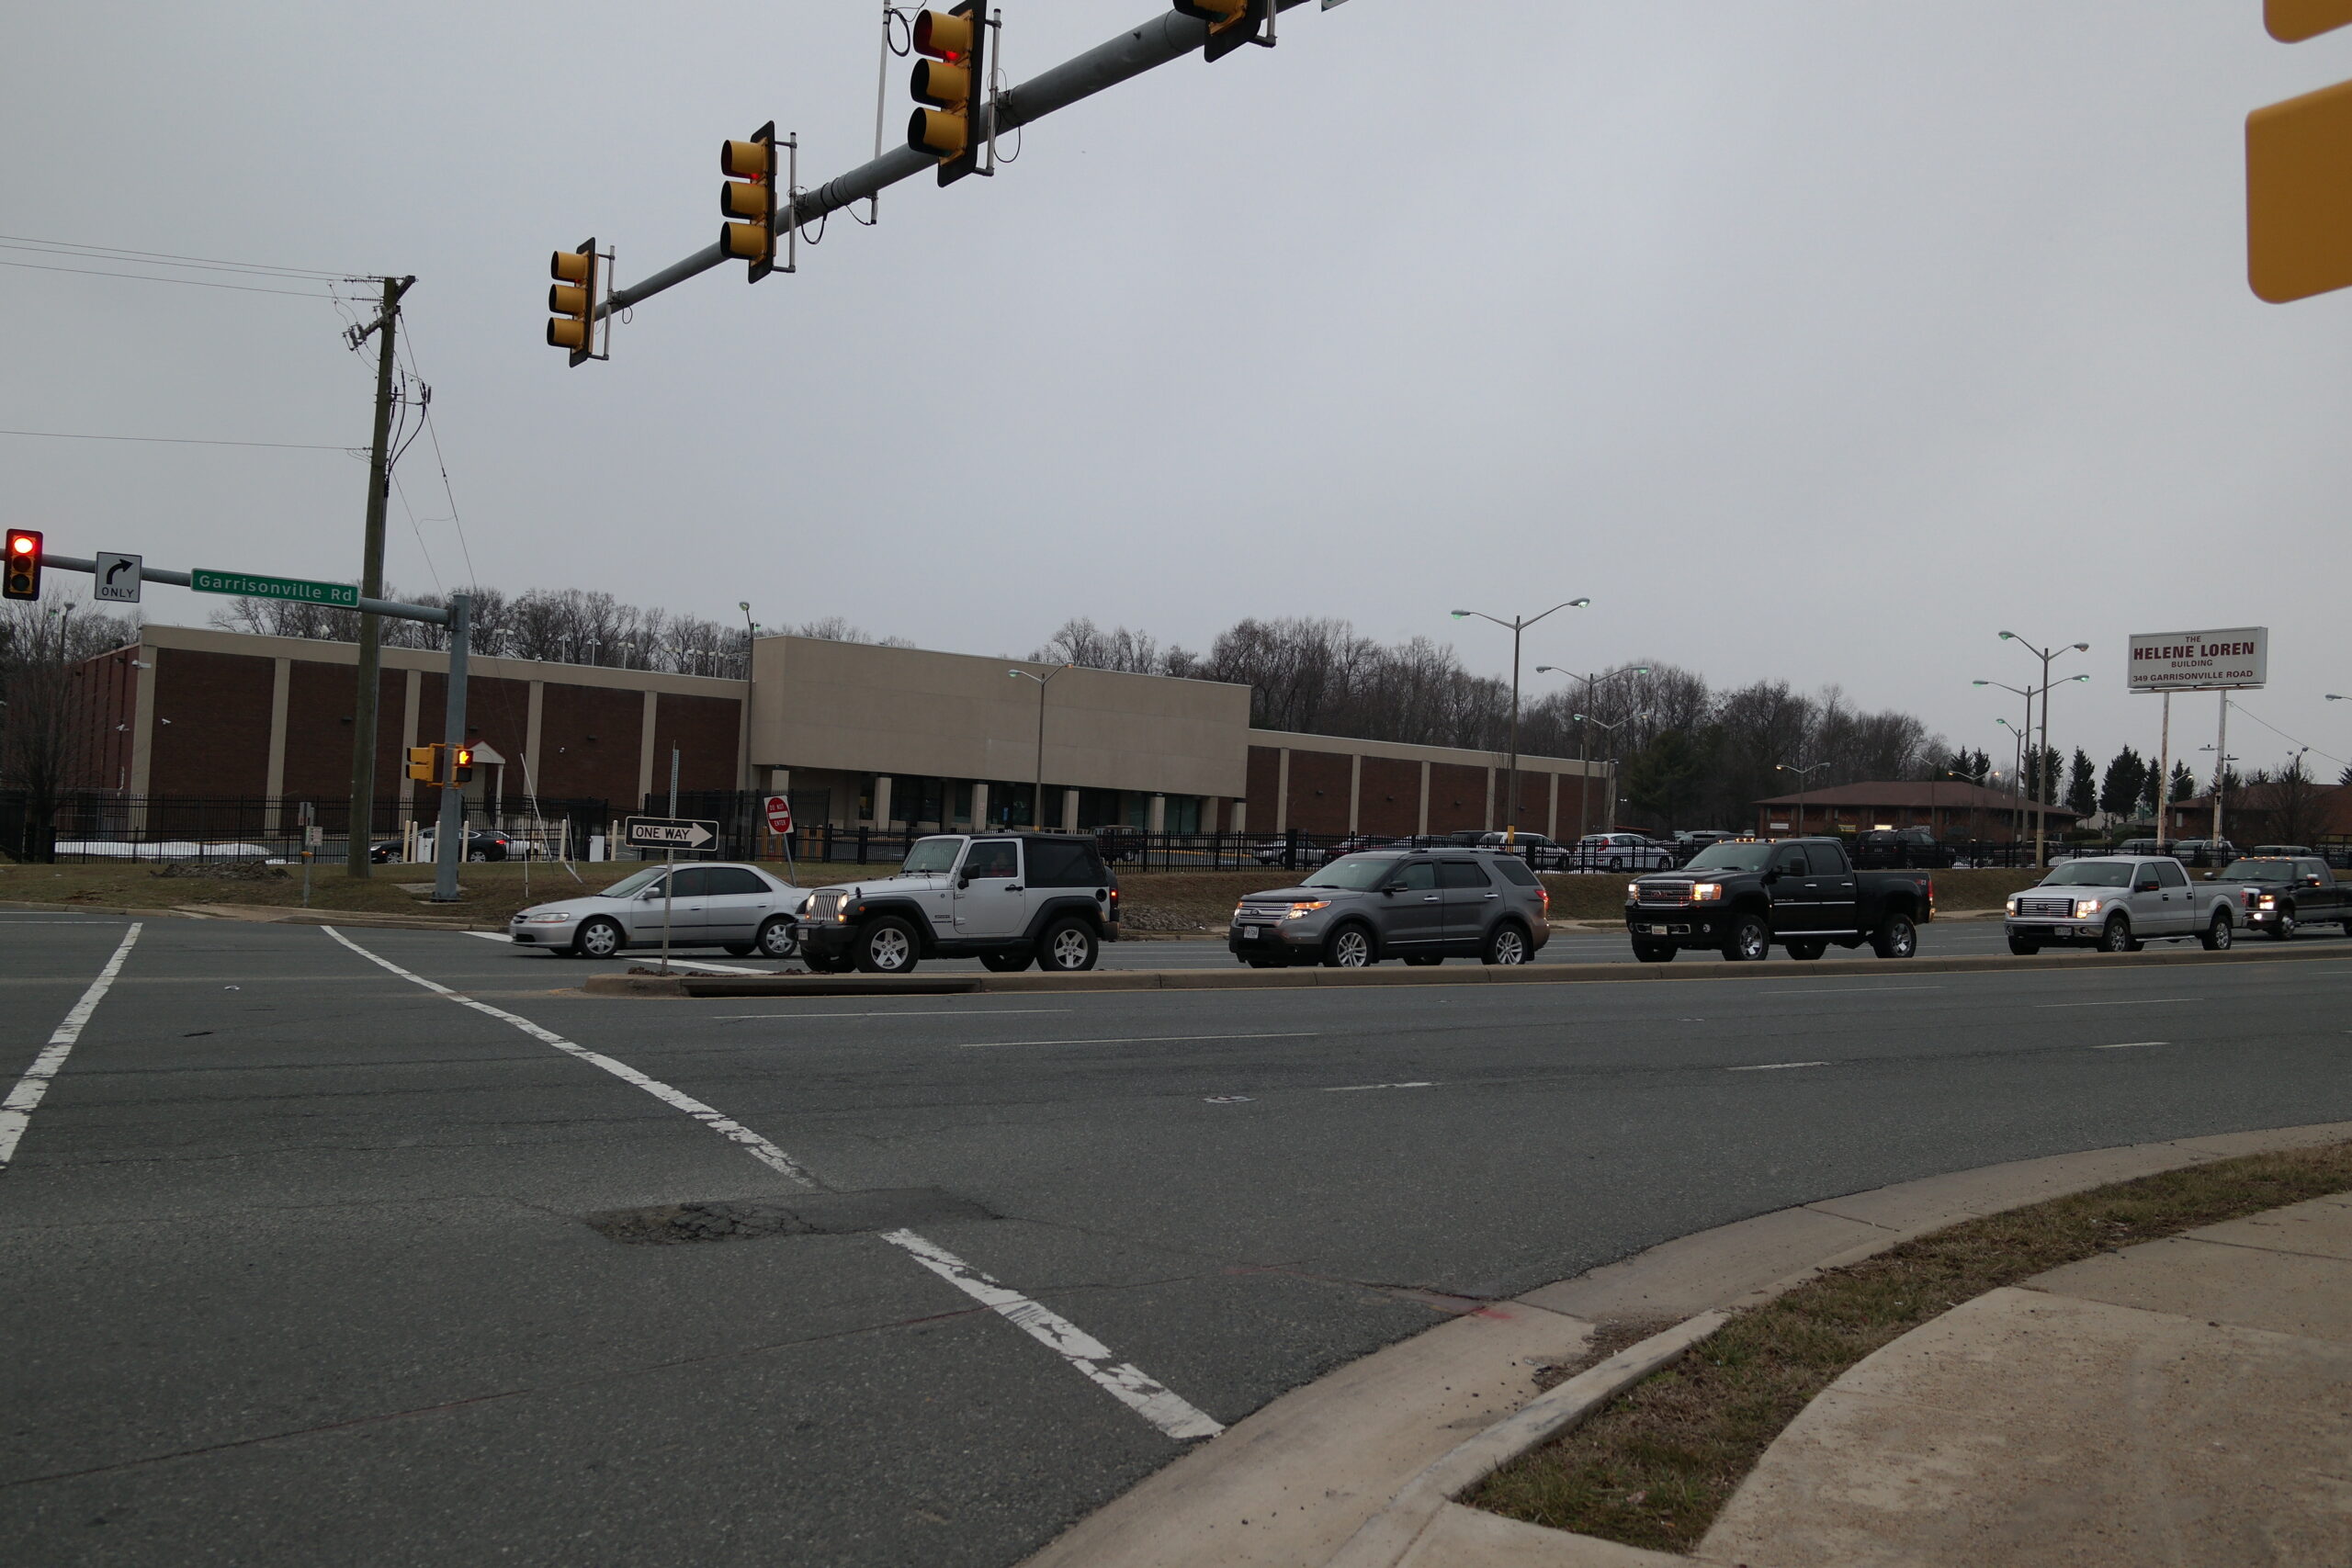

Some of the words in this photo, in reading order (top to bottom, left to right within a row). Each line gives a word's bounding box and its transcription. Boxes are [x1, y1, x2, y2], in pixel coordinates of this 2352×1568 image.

[101, 587, 134, 599] ONLY
[198, 574, 322, 599] Garrisonville
[331, 588, 352, 602] Rd
[2133, 646, 2194, 660] HELENE
[2200, 642, 2255, 658] LOREN
[2171, 660, 2213, 668] BUILDING
[2150, 671, 2223, 682] GARRISONVILLE
[2226, 670, 2254, 678] ROAD
[636, 827, 660, 839] ONE
[665, 829, 691, 840] WAY
